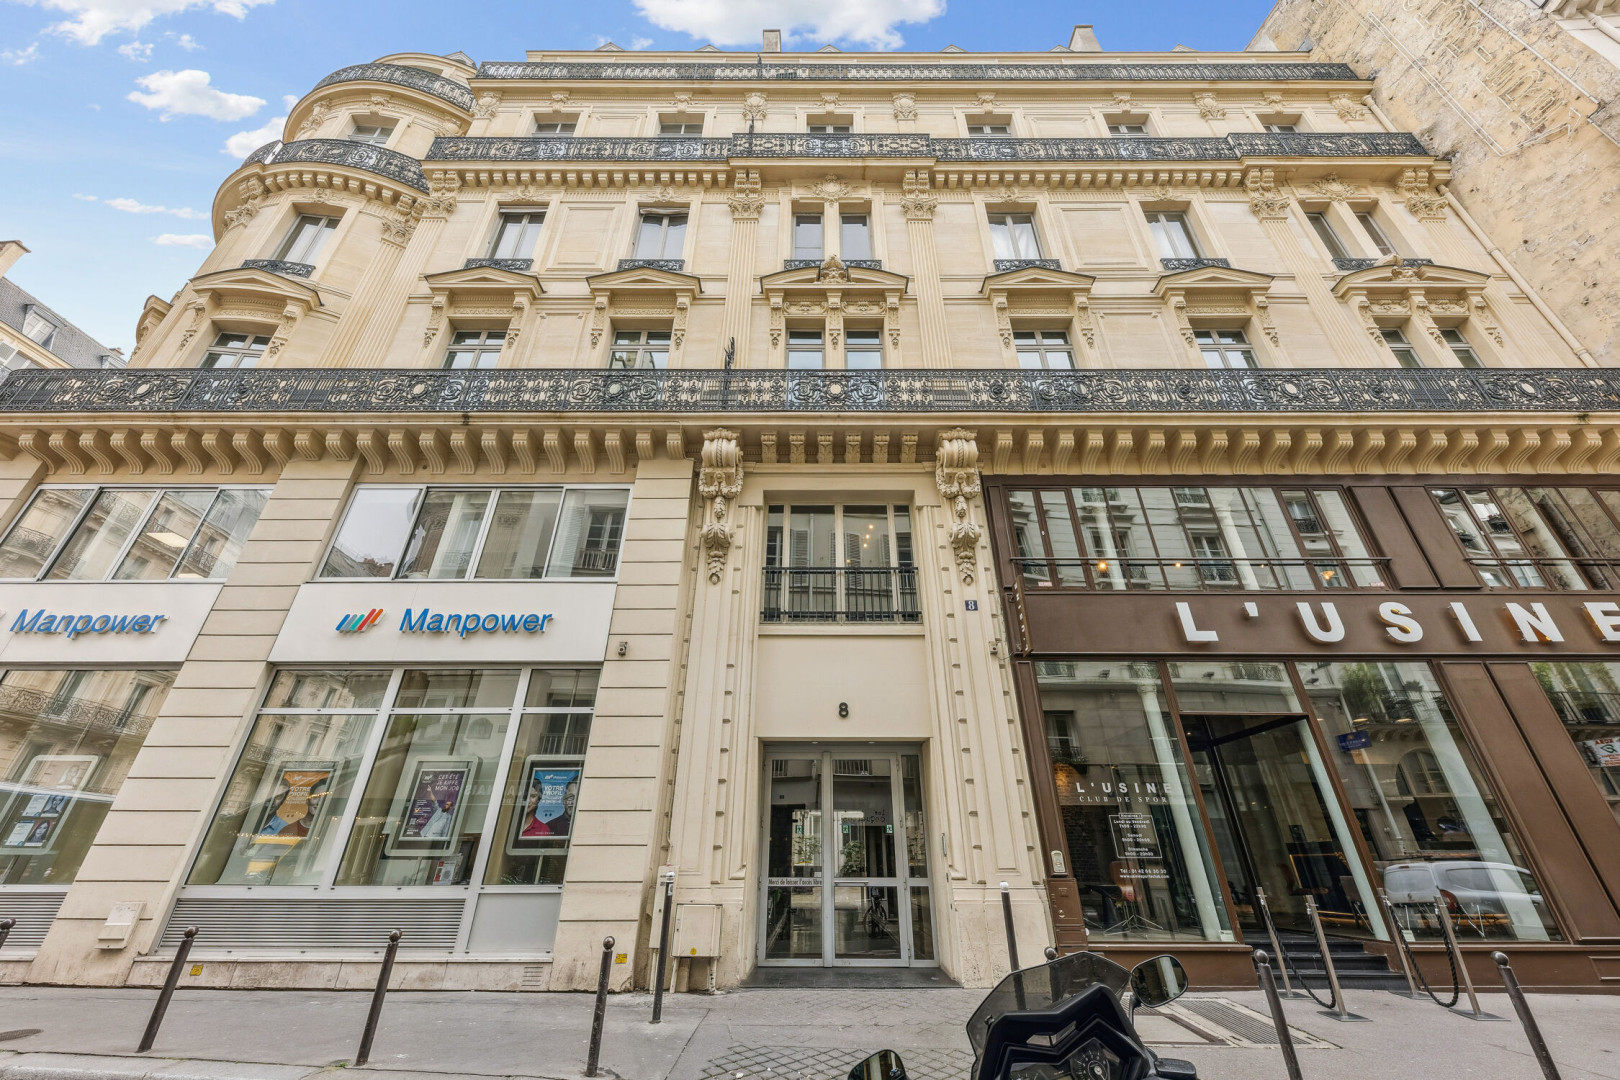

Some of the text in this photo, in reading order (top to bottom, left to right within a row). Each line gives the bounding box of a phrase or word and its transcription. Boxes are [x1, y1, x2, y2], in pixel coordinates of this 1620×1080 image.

[968, 600, 975, 610] 8
[9, 608, 168, 639] Manpower
[399, 608, 553, 638] Manpower
[1175, 601, 1620, 642] L'USINE
[838, 701, 849, 718] 8
[1076, 782, 1172, 793] L'USINE
